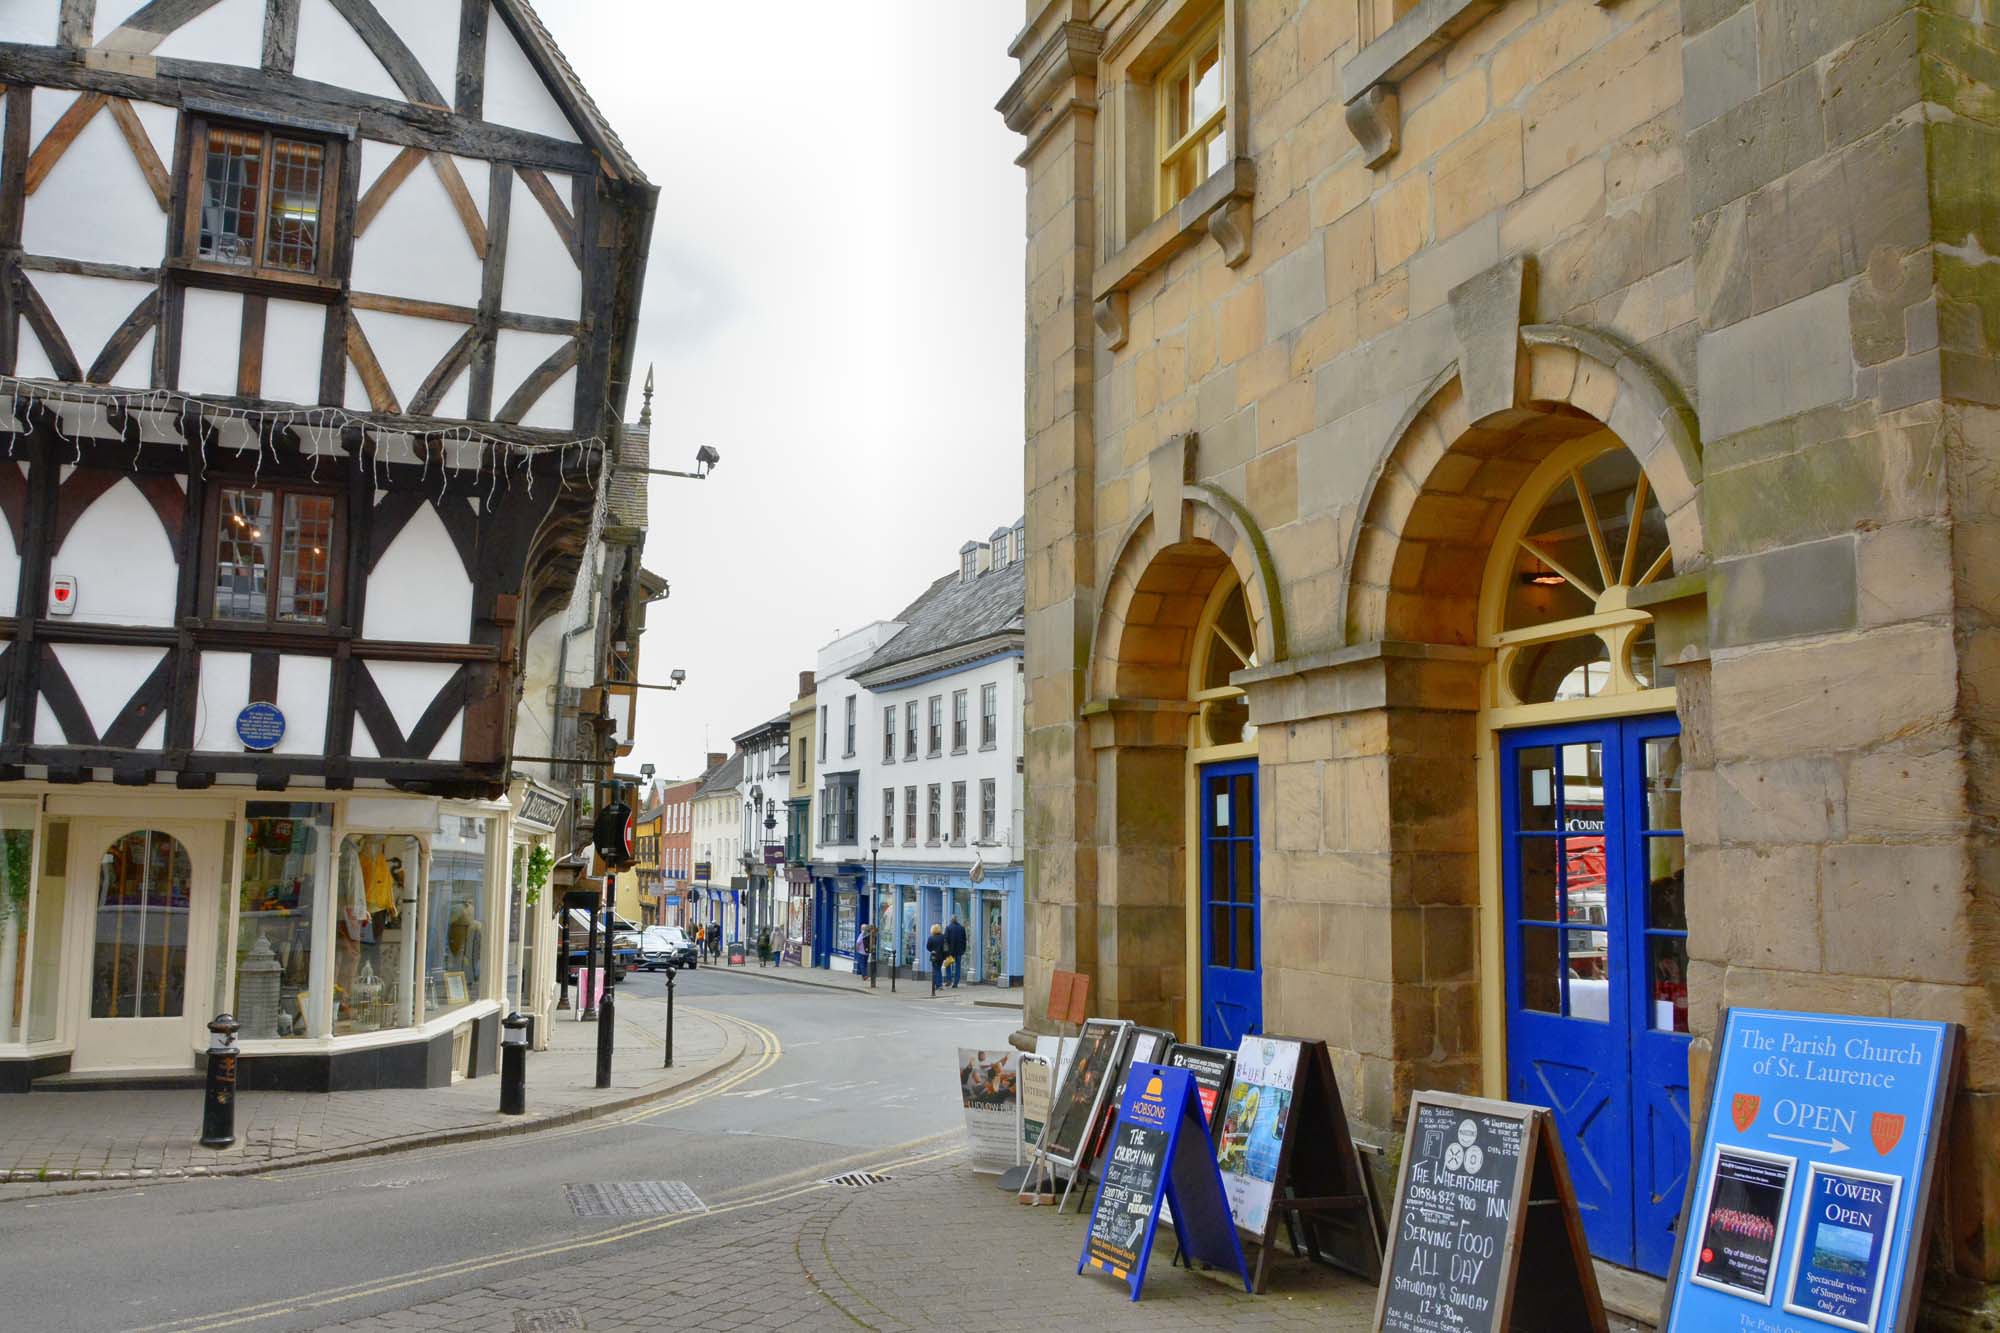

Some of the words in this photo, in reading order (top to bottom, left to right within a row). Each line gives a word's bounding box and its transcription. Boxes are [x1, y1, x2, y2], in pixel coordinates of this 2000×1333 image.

[1741, 1029, 1775, 1050] The
[1781, 1032, 1837, 1057] Parish
[1845, 1038, 1922, 1065] Church
[1174, 1054, 1183, 1066] 12
[1753, 1055, 1776, 1075] of
[1777, 1057, 1799, 1078] St.
[1806, 1061, 1896, 1089] Laurence
[1132, 1101, 1166, 1119] HOBSONS
[1773, 1099, 1857, 1134] OPEN
[1130, 1128, 1147, 1146] THE
[1114, 1145, 1140, 1166] CHURCH
[1140, 1150, 1156, 1167] INN
[1412, 1160, 1430, 1183] THE
[1434, 1161, 1502, 1195] WHEATSHEAF
[1410, 1185, 1437, 1202] 01584
[1438, 1190, 1455, 1206] 872
[1458, 1194, 1476, 1211] 980
[1823, 1177, 1884, 1205] TOWER
[1486, 1197, 1511, 1221] INN
[1825, 1203, 1873, 1228] OPEN
[1404, 1212, 1452, 1249] SERVING
[1457, 1219, 1494, 1259] FOOD
[1410, 1246, 1440, 1276] ALL
[1450, 1254, 1483, 1285] DAY
[1395, 1276, 1437, 1298] SATURDAY
[1449, 1287, 1489, 1311] SUNDAY
[1807, 1272, 1844, 1289] Spectacular
[1846, 1282, 1867, 1294] views
[1811, 1286, 1821, 1295] of
[1820, 1288, 1857, 1304] Shropshire
[1818, 1300, 1834, 1313] Only
[1740, 1313, 1756, 1328] The
